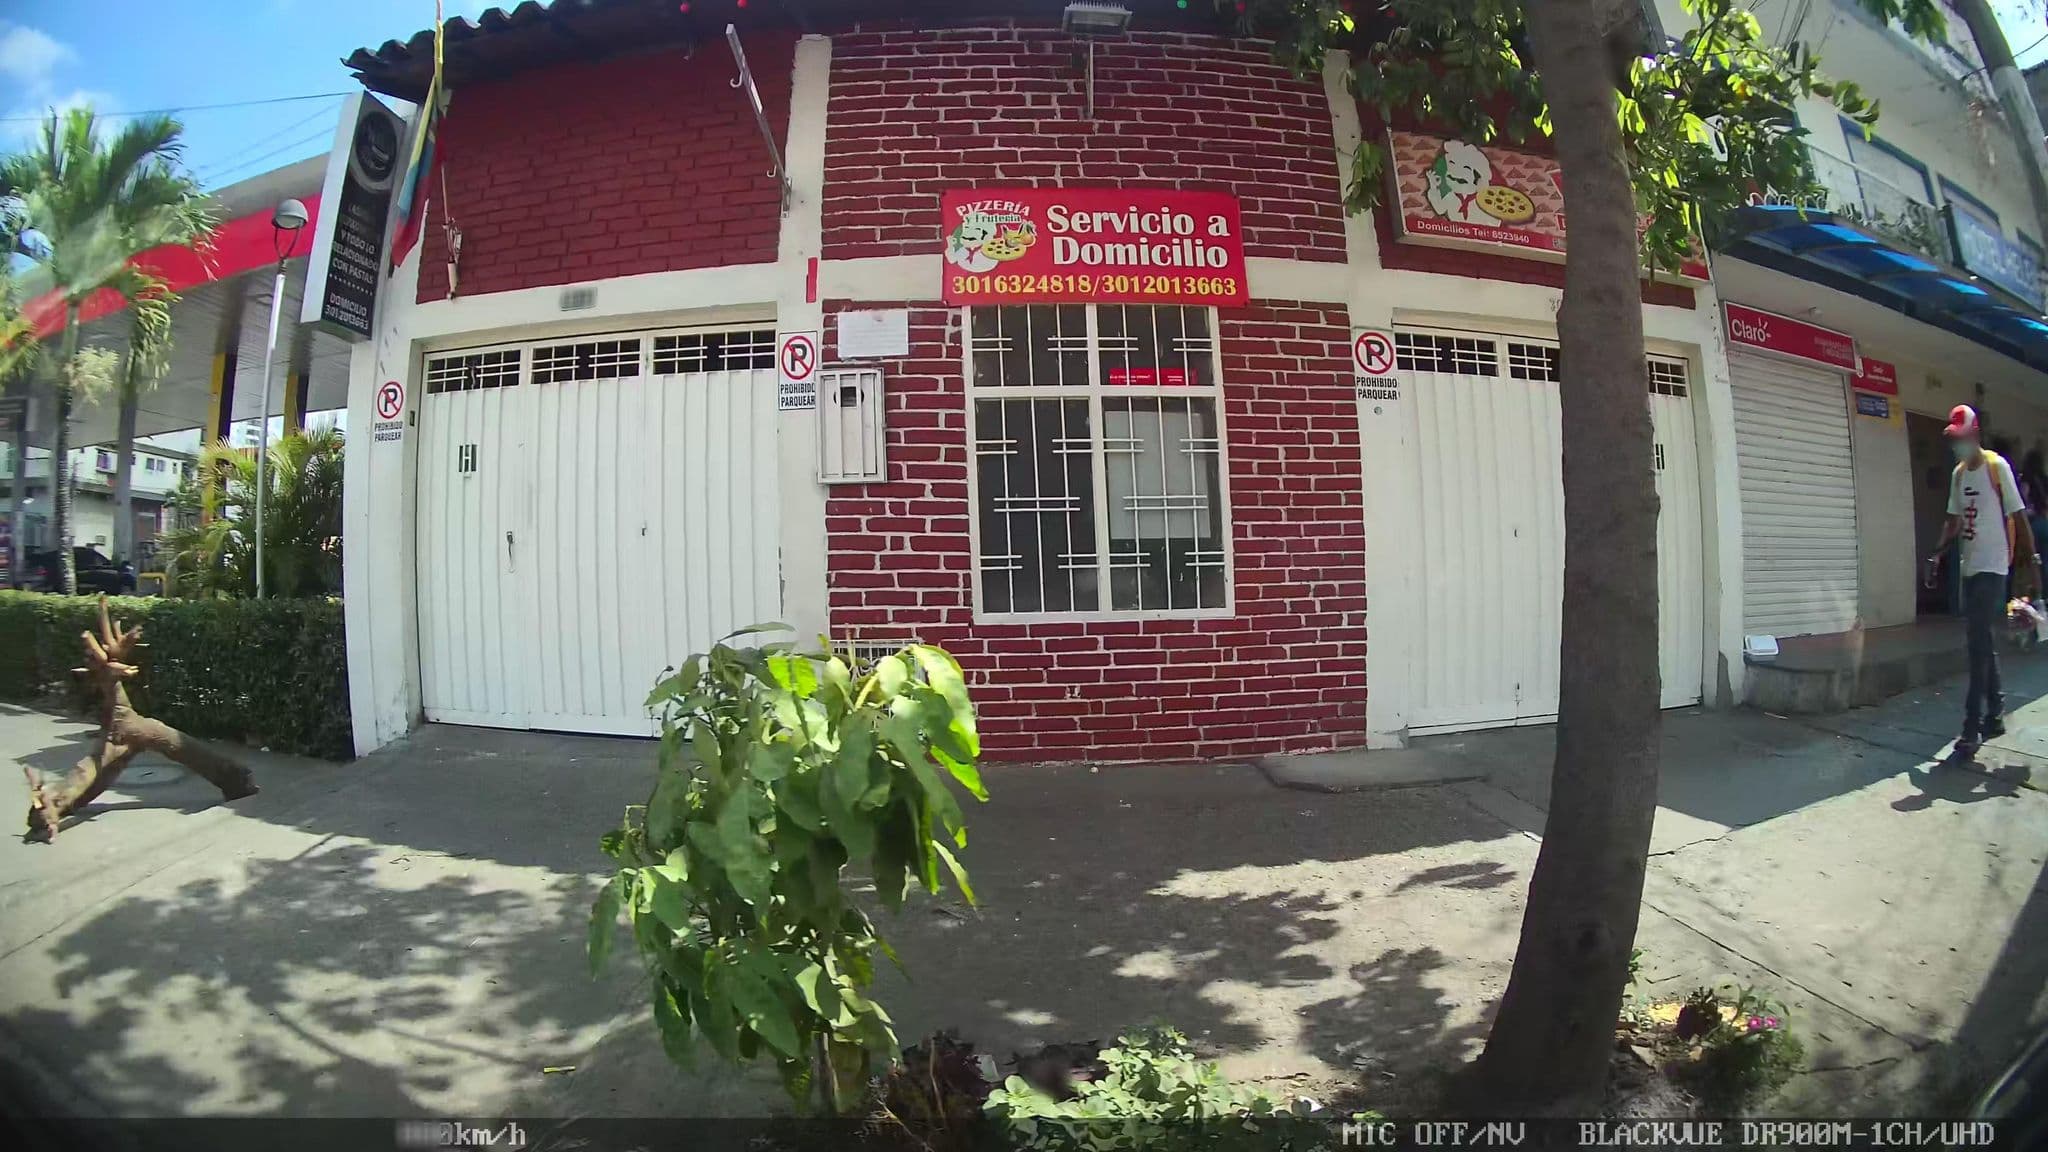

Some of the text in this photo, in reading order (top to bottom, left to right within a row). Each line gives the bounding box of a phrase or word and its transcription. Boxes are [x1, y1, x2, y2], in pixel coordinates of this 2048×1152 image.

[1047, 205, 1231, 237] Servicio a
[1417, 220, 1470, 235] Domicilios
[1053, 237, 1228, 268] Domicilio
[952, 274, 1237, 296] 3016324818/3012013663
[329, 292, 367, 316] DOMICILIO
[1731, 318, 1766, 342] Claro
[1356, 375, 1398, 388] PROHIBIDO
[1357, 388, 1398, 400] PARQUEAR
